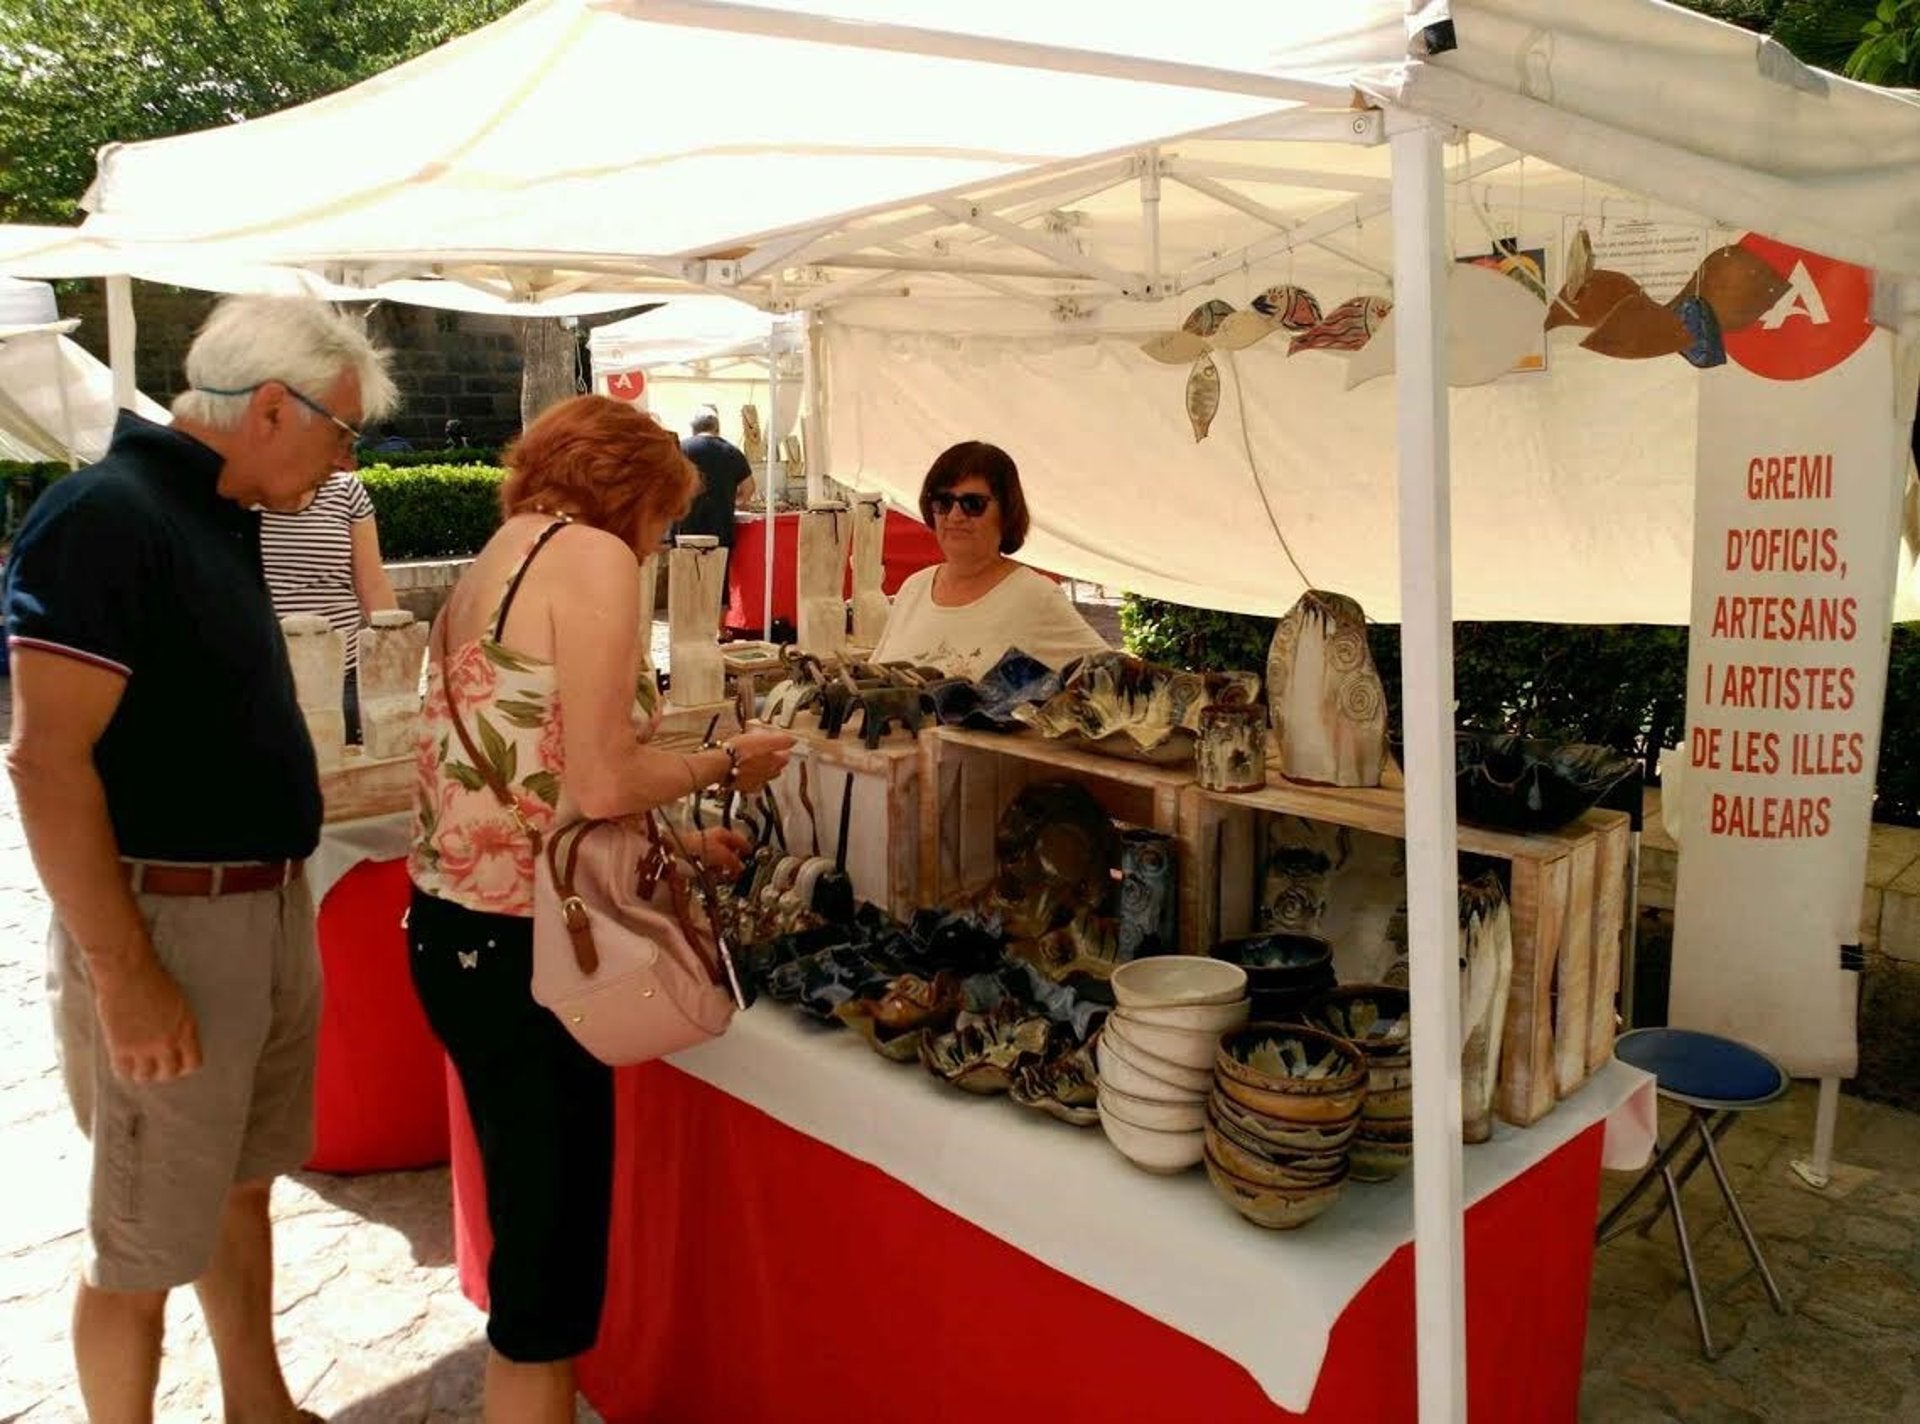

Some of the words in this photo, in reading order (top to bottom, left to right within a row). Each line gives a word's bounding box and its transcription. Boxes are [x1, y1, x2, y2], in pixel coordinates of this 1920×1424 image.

[1747, 455, 1833, 500] GREMI
[1726, 527, 1848, 580] D'OFICIS,
[1712, 596, 1858, 641] ARTESANS
[1705, 664, 1713, 705] I
[1721, 665, 1855, 710] ARTISTES
[1692, 727, 1722, 769] DE
[1731, 730, 1779, 774] LES
[1792, 732, 1864, 774] ILLES
[1711, 793, 1831, 839] BALEARS
